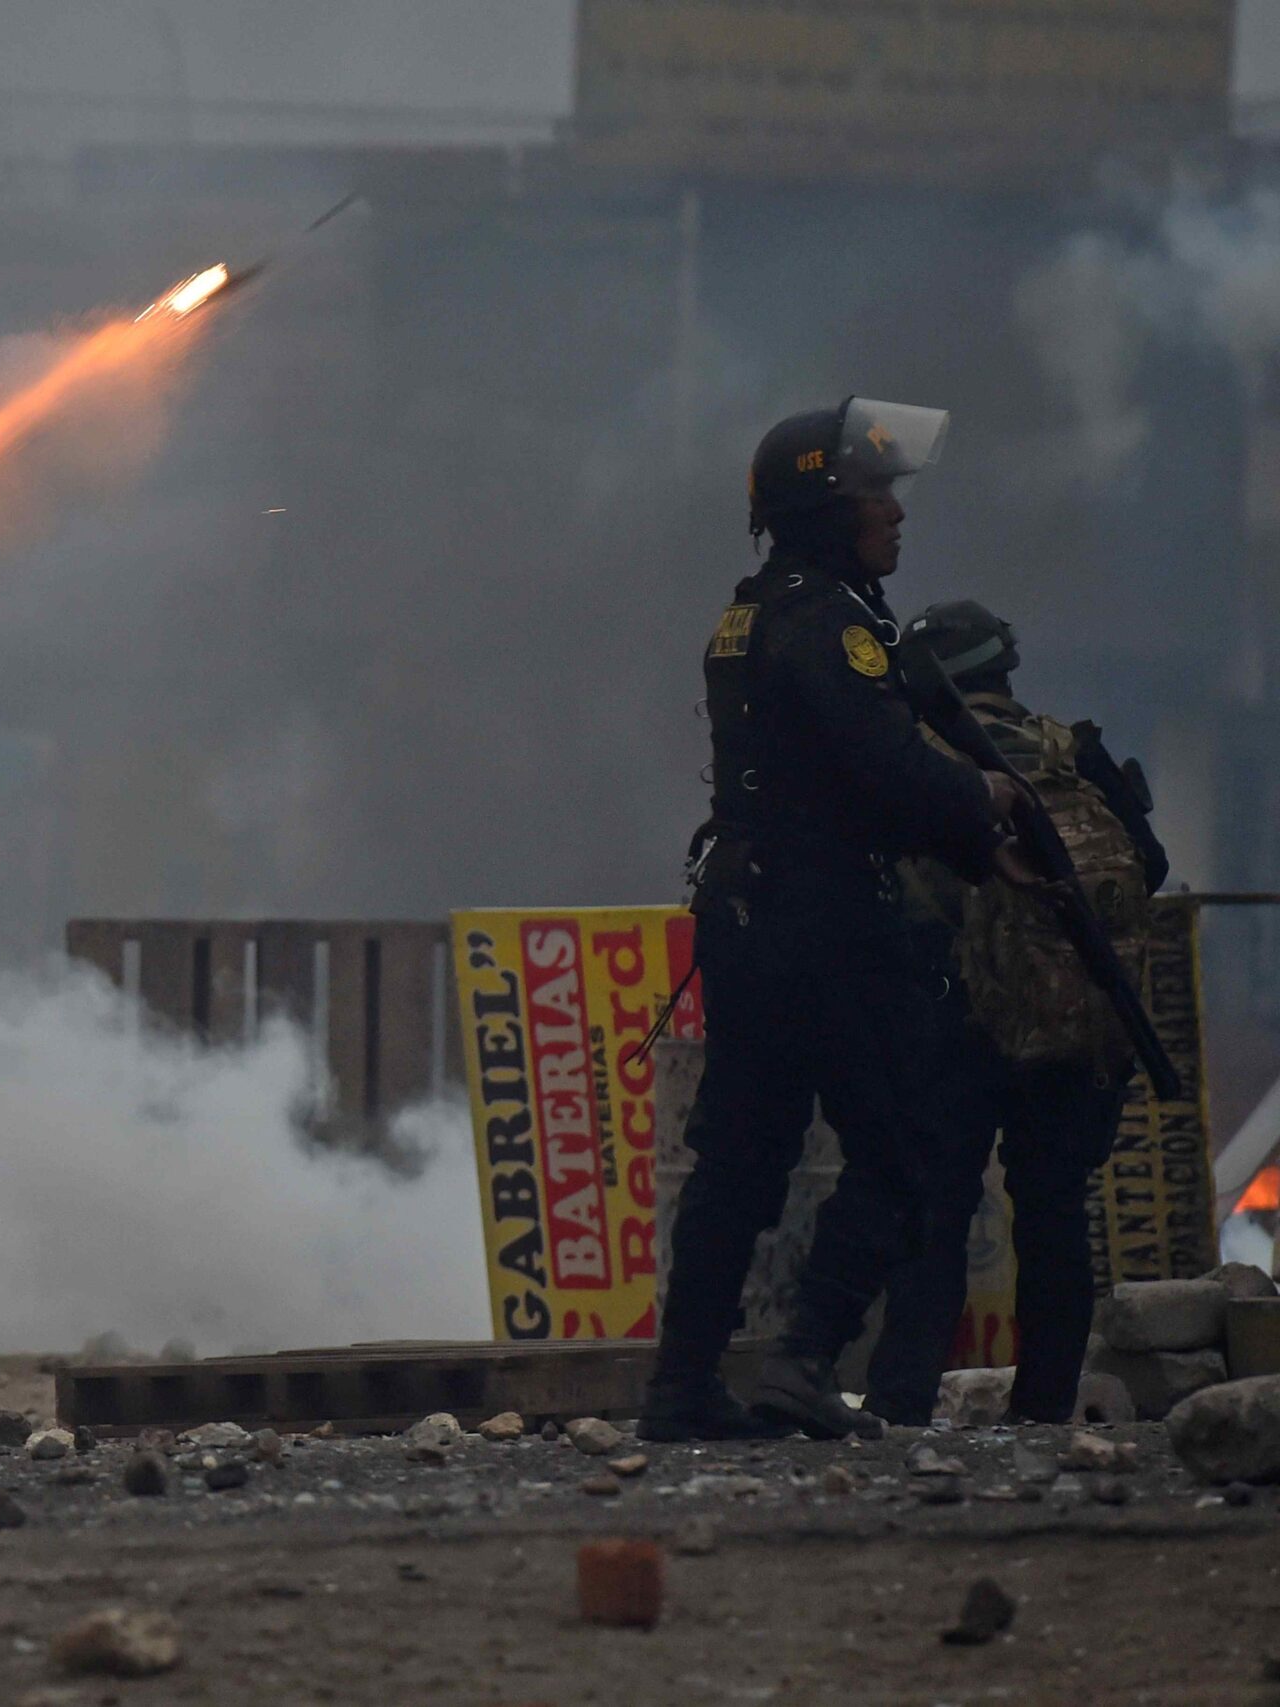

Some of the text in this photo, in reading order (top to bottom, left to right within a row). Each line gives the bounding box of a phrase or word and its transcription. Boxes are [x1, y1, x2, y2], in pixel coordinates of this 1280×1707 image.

[797, 450, 825, 473] USE
[527, 928, 605, 1280] BATERIAS
[589, 1024, 618, 1187] BATERIAS
[592, 923, 657, 1284] Record
